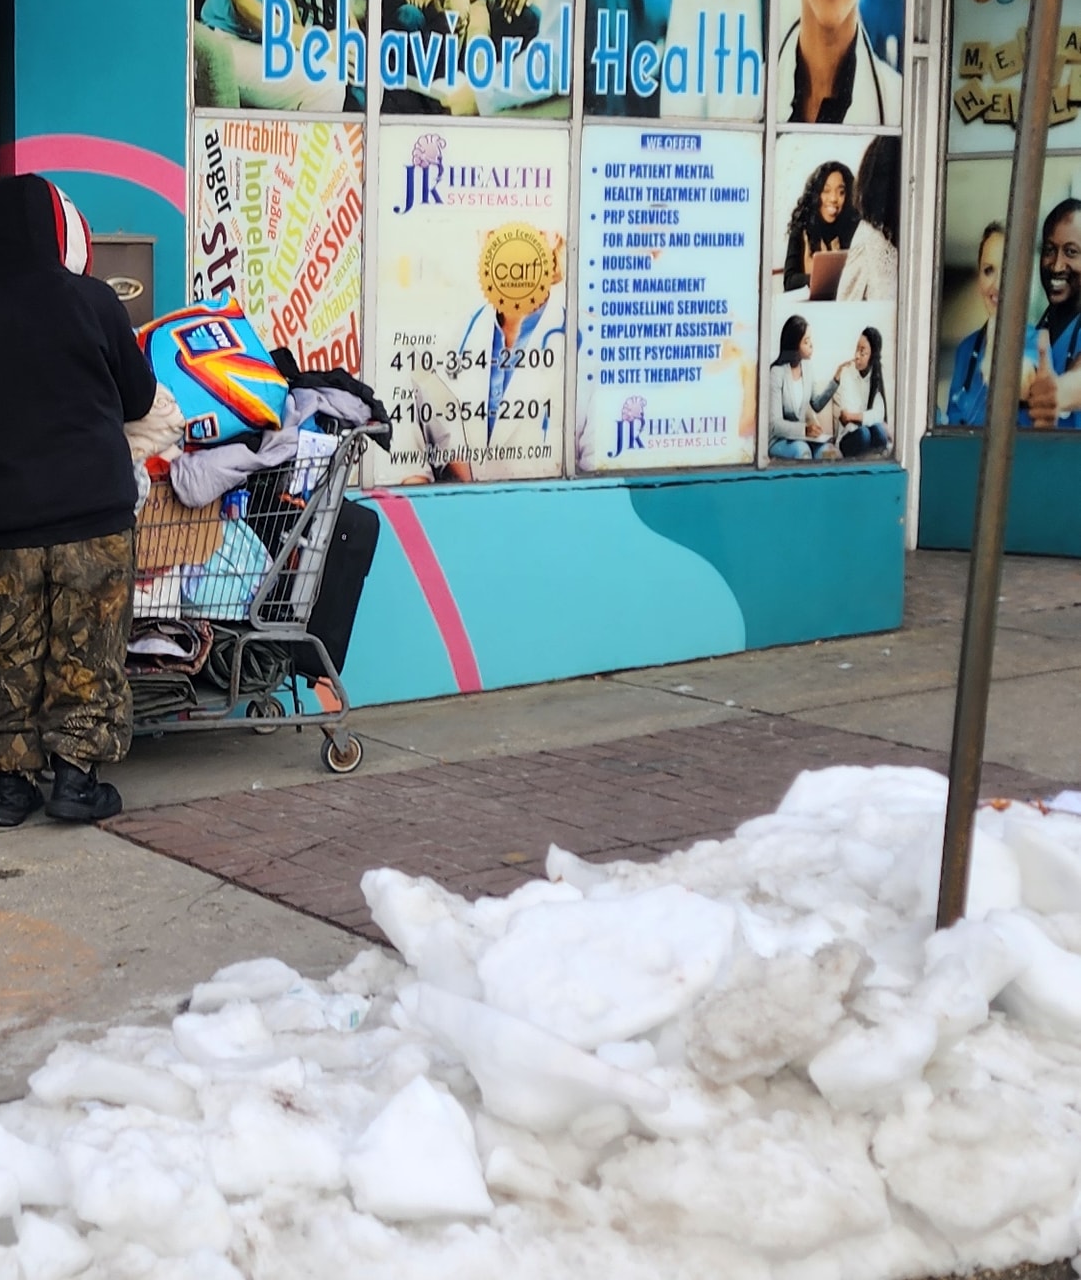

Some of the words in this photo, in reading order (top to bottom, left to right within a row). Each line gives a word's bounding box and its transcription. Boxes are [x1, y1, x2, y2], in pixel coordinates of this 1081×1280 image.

[593, 8, 765, 98] Health
[647, 136, 662, 149] WE
[665, 136, 698, 151] OFFER
[205, 128, 232, 215] anger
[448, 165, 552, 188] HEALTH
[605, 163, 626, 179] OUT
[629, 164, 672, 179] PATIENT
[674, 164, 715, 180] MENTAL
[604, 186, 643, 202] HEALTH
[647, 187, 707, 202] TREATMENT
[268, 185, 282, 240] anger
[603, 209, 625, 225] PRP
[628, 209, 680, 225] SERVICES
[240, 160, 270, 315] hopeless
[304, 223, 321, 255] stress
[603, 232, 623, 248] FOR
[626, 232, 666, 248] ADULTS
[669, 232, 691, 247] AND
[693, 232, 745, 248] CHILDREN
[270, 187, 362, 348] depression
[333, 243, 361, 287] anxiety
[494, 258, 541, 281] carf
[602, 255, 652, 270] HOUSING
[602, 278, 629, 294] CASE
[632, 277, 706, 293] MANAGEMENT
[601, 300, 674, 317] COUNSELLING
[677, 300, 728, 315] SERVICES
[393, 332, 437, 346] Phone:
[601, 323, 673, 339] EMPLOYMENT
[675, 322, 733, 338] ASSISTANT
[391, 348, 555, 371] 410-354-2200
[600, 346, 616, 362] ON
[618, 346, 641, 361] SITE
[644, 344, 721, 361] PSYCHIATRIST
[600, 369, 615, 385] ON
[618, 368, 641, 384] SITE
[644, 367, 702, 383] THERAPIST
[393, 387, 419, 400] Fax:
[390, 398, 552, 424] 410-354-2201
[648, 416, 727, 435] HEALTH
[390, 444, 552, 467] www.jkhealthsystems.com
